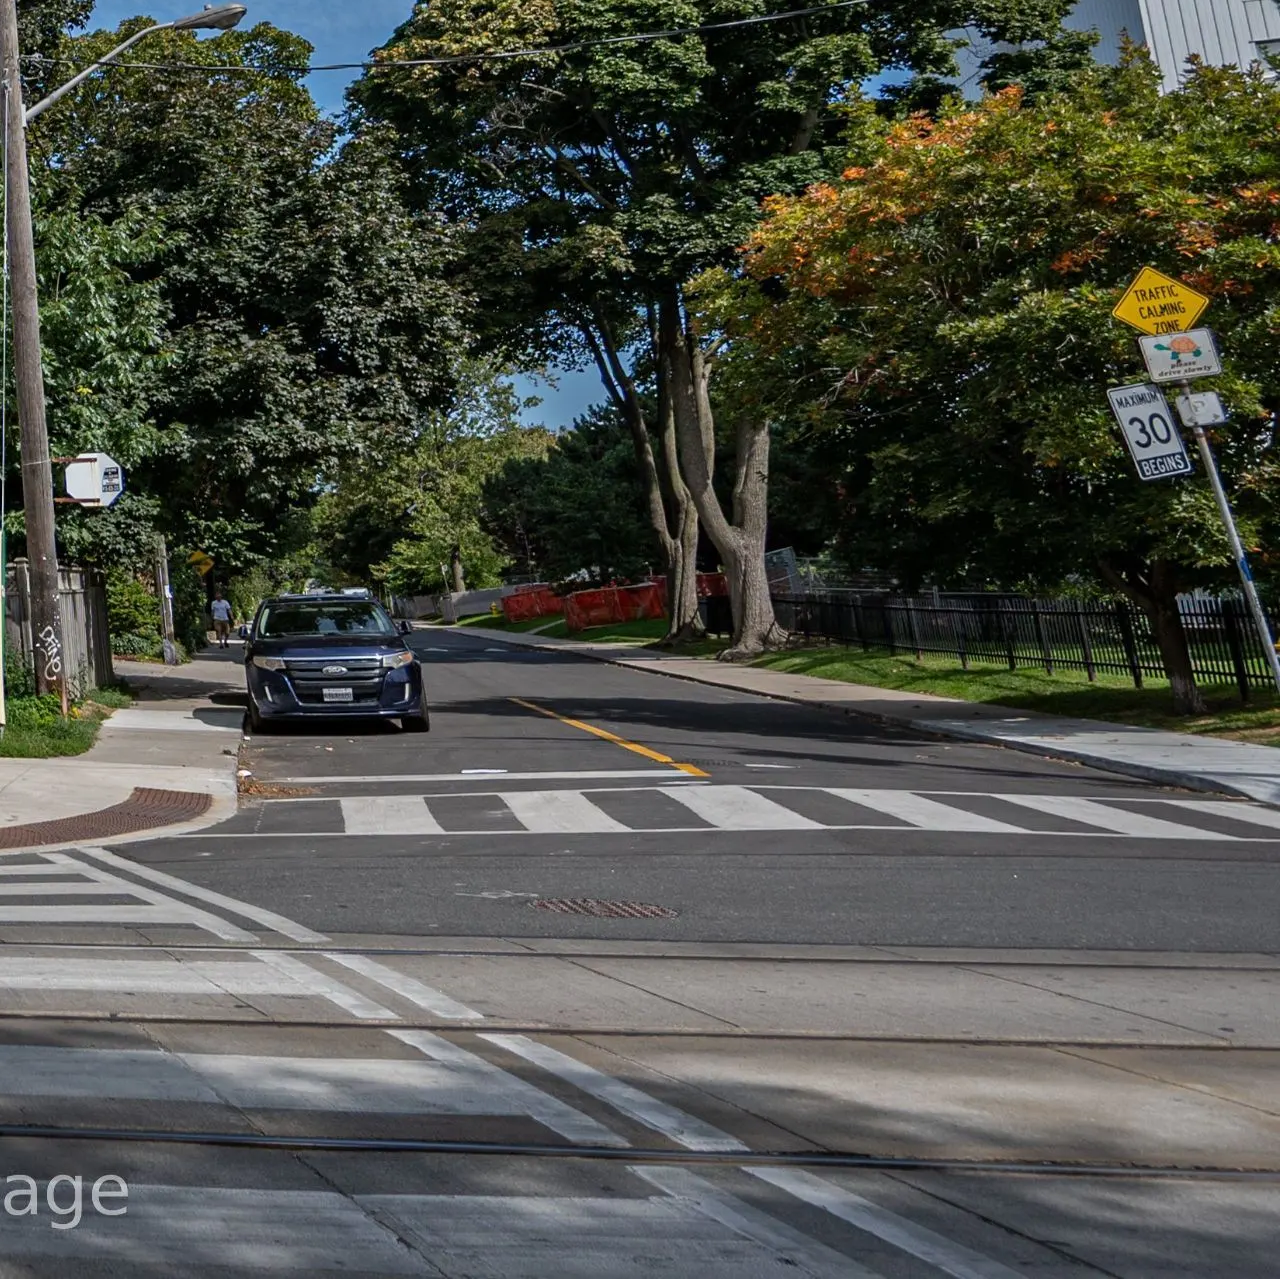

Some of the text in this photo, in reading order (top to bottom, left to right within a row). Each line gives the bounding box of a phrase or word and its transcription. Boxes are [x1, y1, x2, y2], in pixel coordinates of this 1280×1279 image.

[1133, 284, 1179, 303] TRAFFIC
[1139, 301, 1187, 319] CALMING
[1154, 320, 1182, 334] ZONE
[1115, 391, 1159, 409] MAXIMUM
[1128, 413, 1171, 449] 30
[1141, 455, 1185, 477] BEGINS
